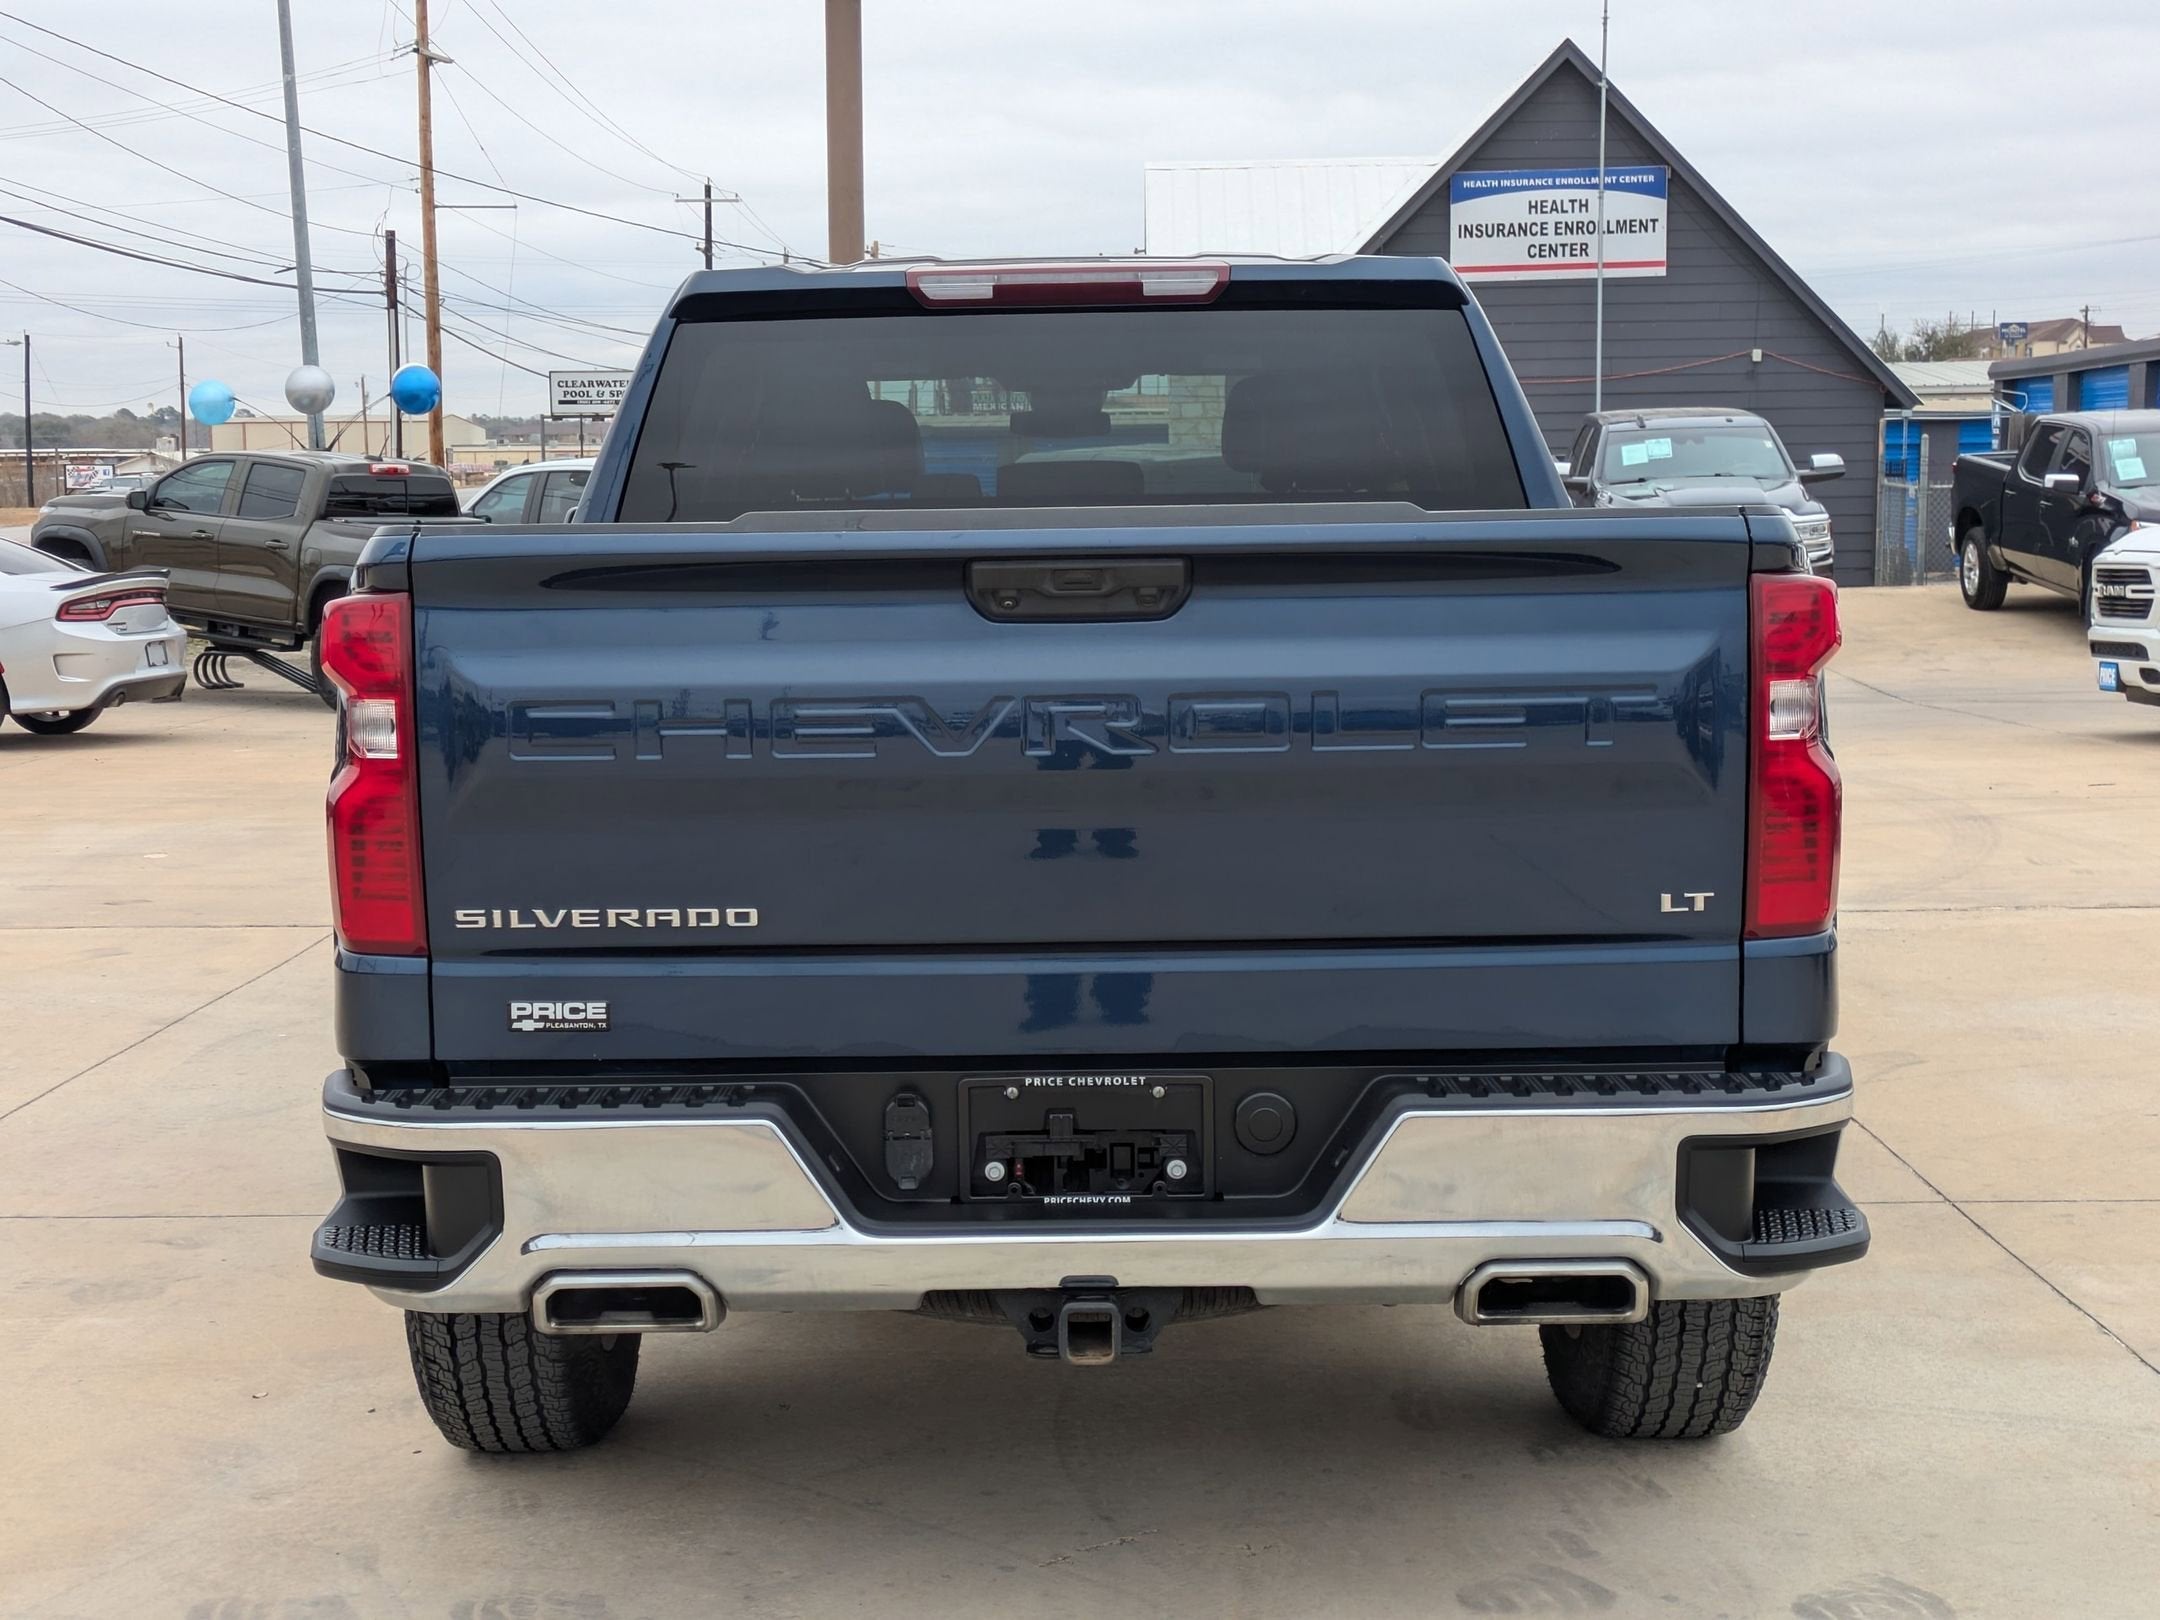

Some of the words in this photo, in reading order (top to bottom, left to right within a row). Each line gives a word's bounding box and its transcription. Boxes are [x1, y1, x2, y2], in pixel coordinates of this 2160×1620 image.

[1463, 180, 1498, 189] HEALTH
[1500, 178, 1553, 187] INSURANCE
[1555, 176, 1617, 186] ENROLLMNT
[1619, 175, 1655, 184] CENTER
[1528, 199, 1589, 215] HEALTH
[1458, 222, 1549, 239] INSURANCE
[1527, 242, 1589, 259] CENTER
[563, 390, 592, 398] POOL
[596, 390, 605, 398] &
[507, 683, 1657, 759] CHEVROLET
[1661, 892, 1715, 912] LT
[455, 908, 759, 929] SILVERADO
[511, 1002, 607, 1019] PRICE
[1025, 1077, 1063, 1087] PRICE
[1068, 1076, 1146, 1086] CHEVROLET
[1044, 1195, 1131, 1204] PRICECHEVYCOM
